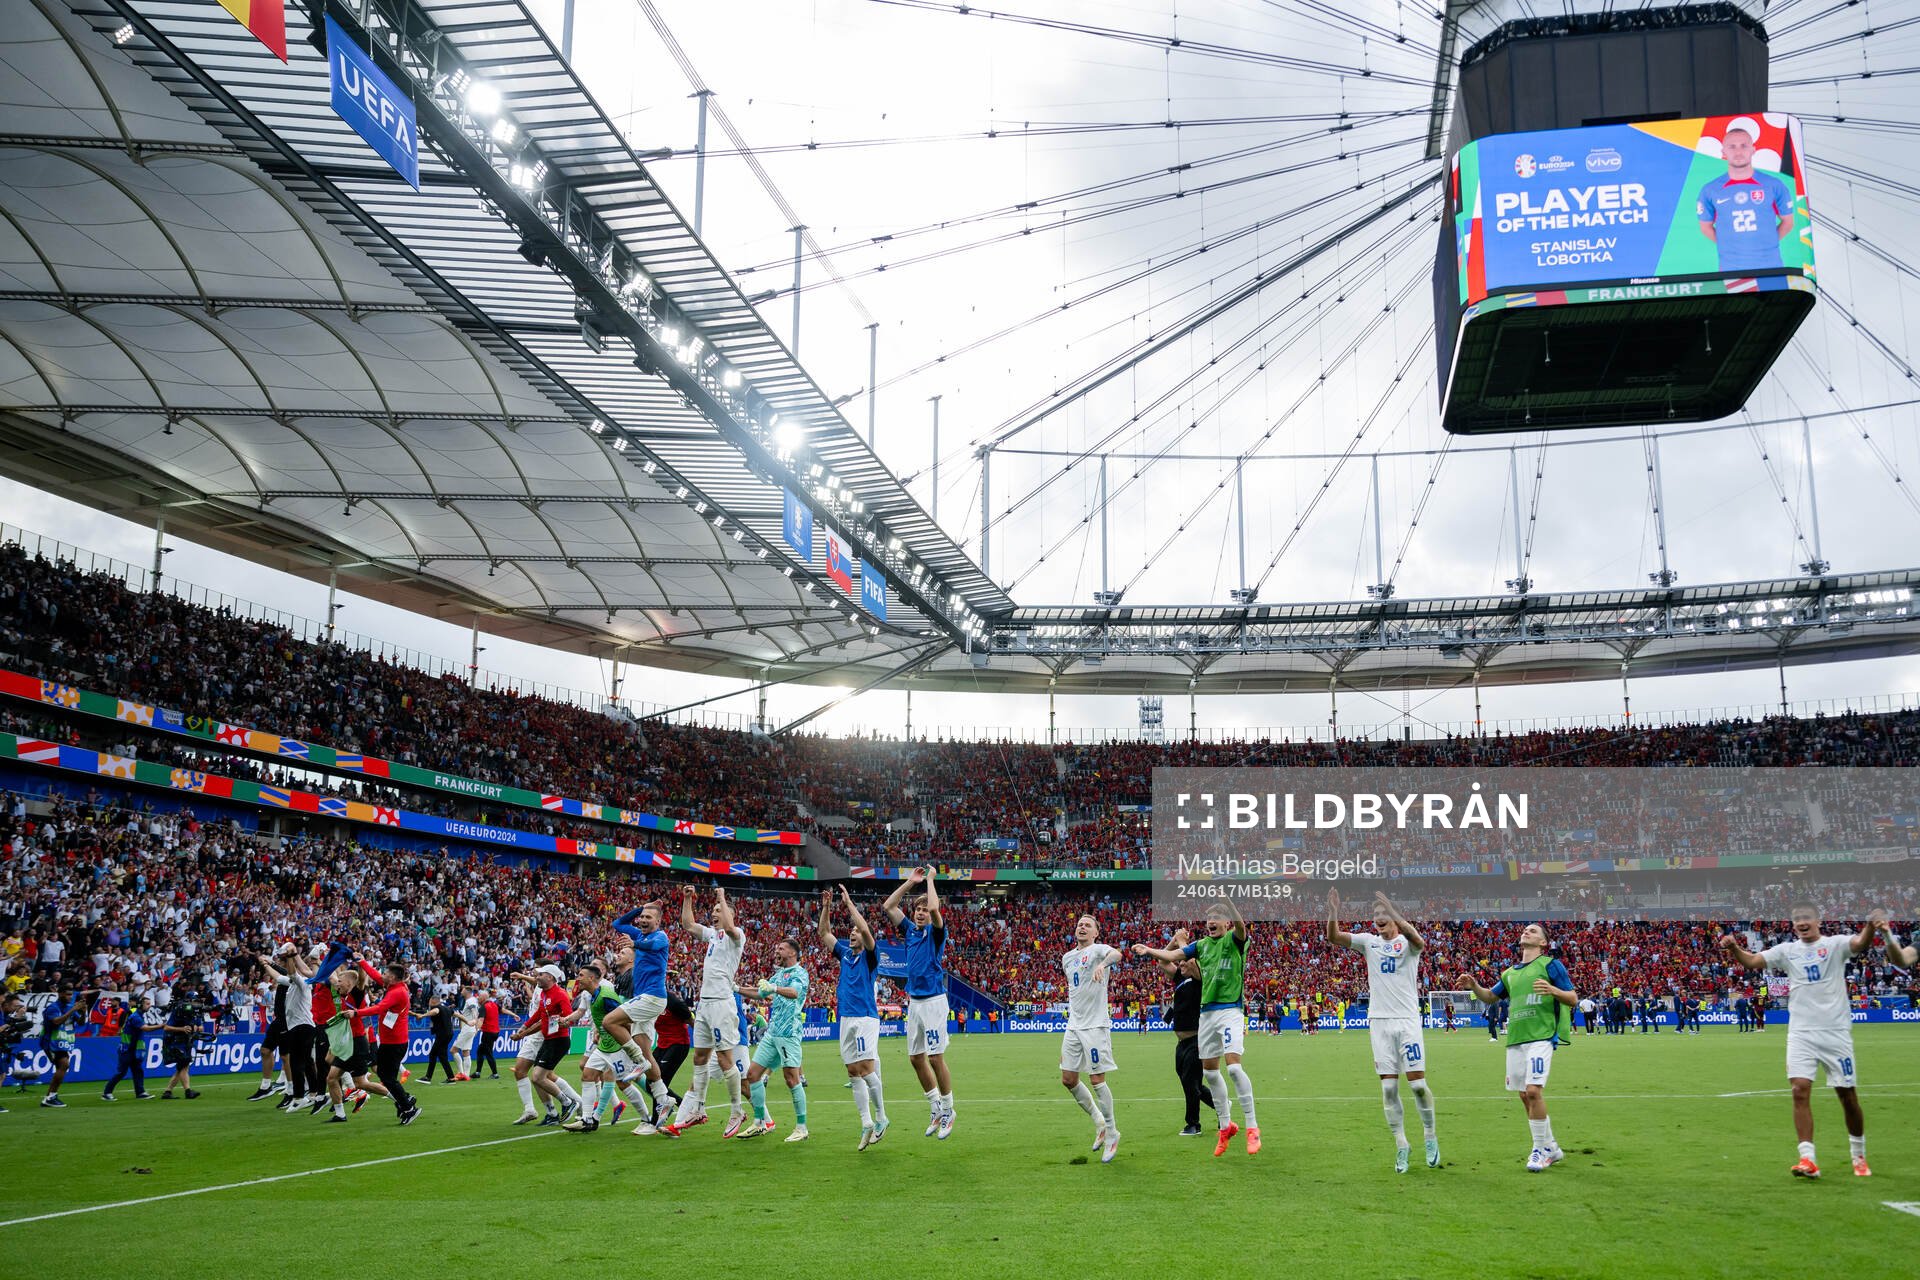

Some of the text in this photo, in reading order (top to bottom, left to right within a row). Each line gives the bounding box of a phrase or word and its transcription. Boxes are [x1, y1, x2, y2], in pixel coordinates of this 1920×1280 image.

[340, 52, 412, 155] UEFA
[1587, 157, 1620, 167] vivo
[1496, 183, 1648, 217] PLAYER
[1496, 208, 1648, 233] OF THE MATCH
[1731, 209, 1757, 233] 22
[1530, 237, 1617, 255] STANISLAV
[1536, 251, 1614, 267] LOBOTKA
[1587, 282, 1704, 302] FRANKFURT
[865, 575, 885, 607] FIFA
[434, 775, 503, 798] FRANKFURT
[1772, 852, 1854, 864] FRANKFURT
[1380, 956, 1396, 974] 20
[1073, 972, 1080, 987] 8
[714, 1027, 721, 1042] 9
[926, 1030, 939, 1045] 24
[1223, 1027, 1232, 1044] 5
[782, 1046, 788, 1059] 1
[857, 1036, 866, 1052] 11
[1405, 1043, 1420, 1061] 20
[1090, 1047, 1100, 1064] 8
[613, 1060, 625, 1074] 15
[1530, 1057, 1545, 1074] 10
[1840, 1058, 1853, 1076] 18
